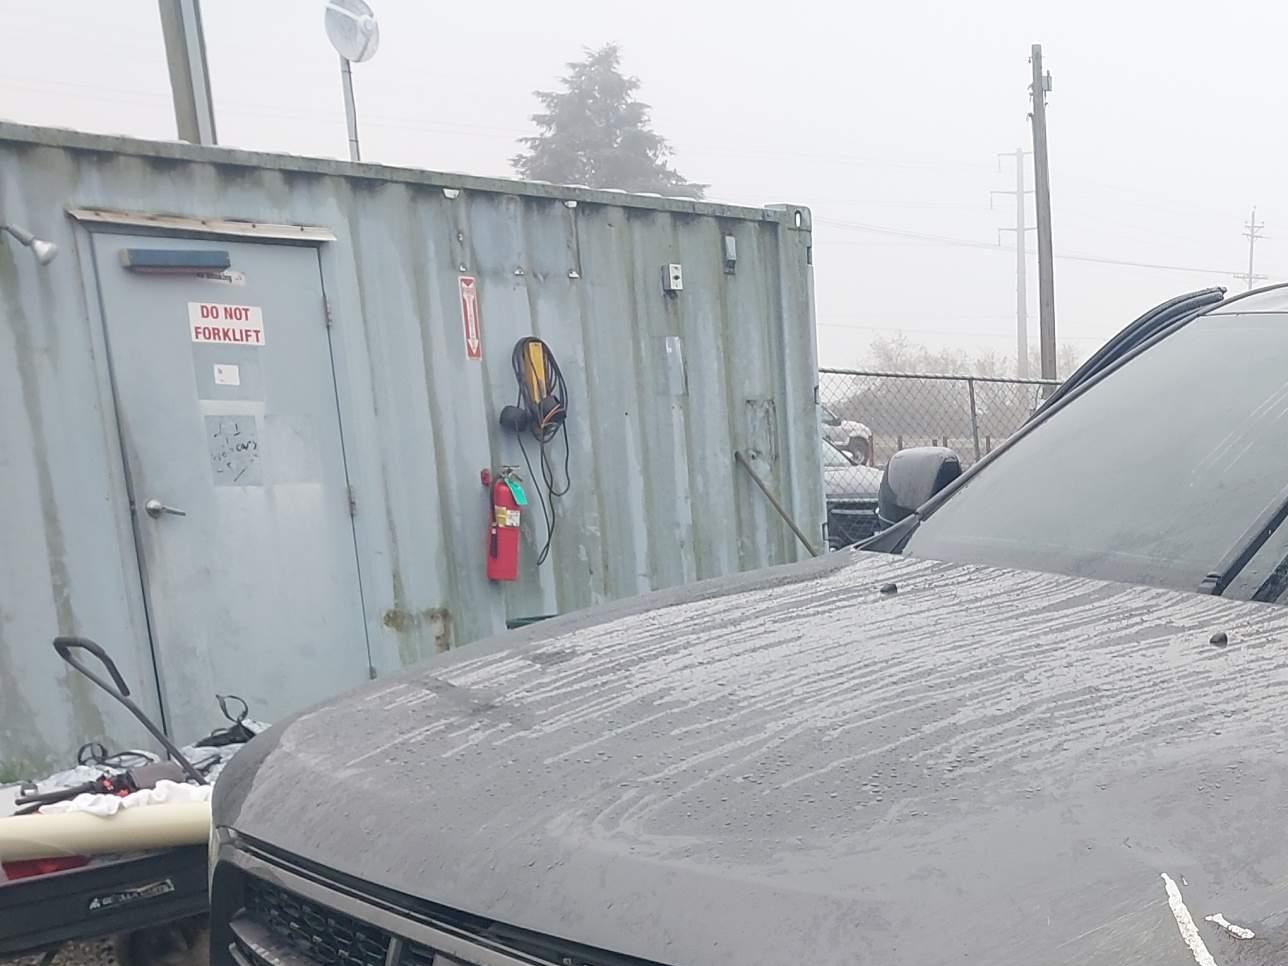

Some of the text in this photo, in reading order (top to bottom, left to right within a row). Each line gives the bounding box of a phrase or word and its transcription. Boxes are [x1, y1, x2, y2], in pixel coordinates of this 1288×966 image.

[200, 304, 250, 321] DO NOT
[194, 326, 261, 343] FORKLIFT
